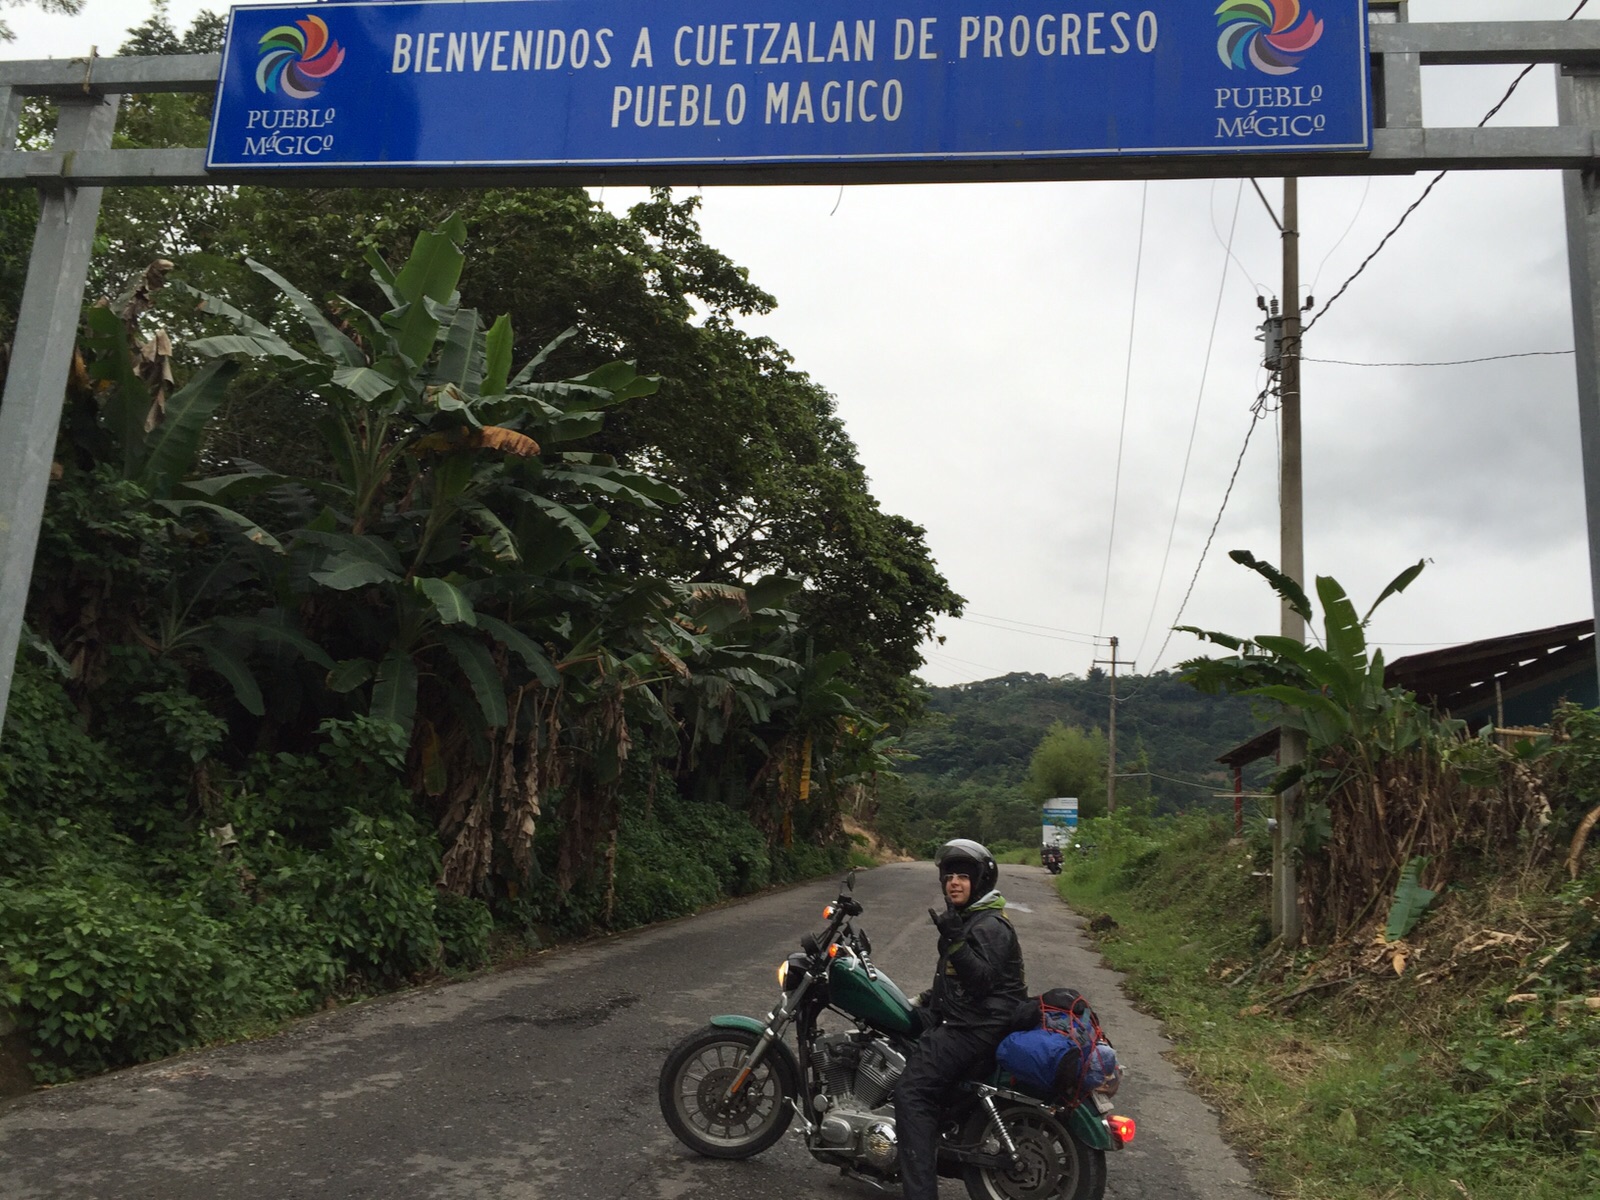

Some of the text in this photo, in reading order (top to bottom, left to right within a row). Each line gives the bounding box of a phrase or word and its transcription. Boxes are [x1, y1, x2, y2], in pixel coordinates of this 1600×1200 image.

[392, 10, 1158, 73] BIENVENIDOS A CUETZALAN DE PROGRESO
[611, 78, 903, 128] PUEBLO MAGICO
